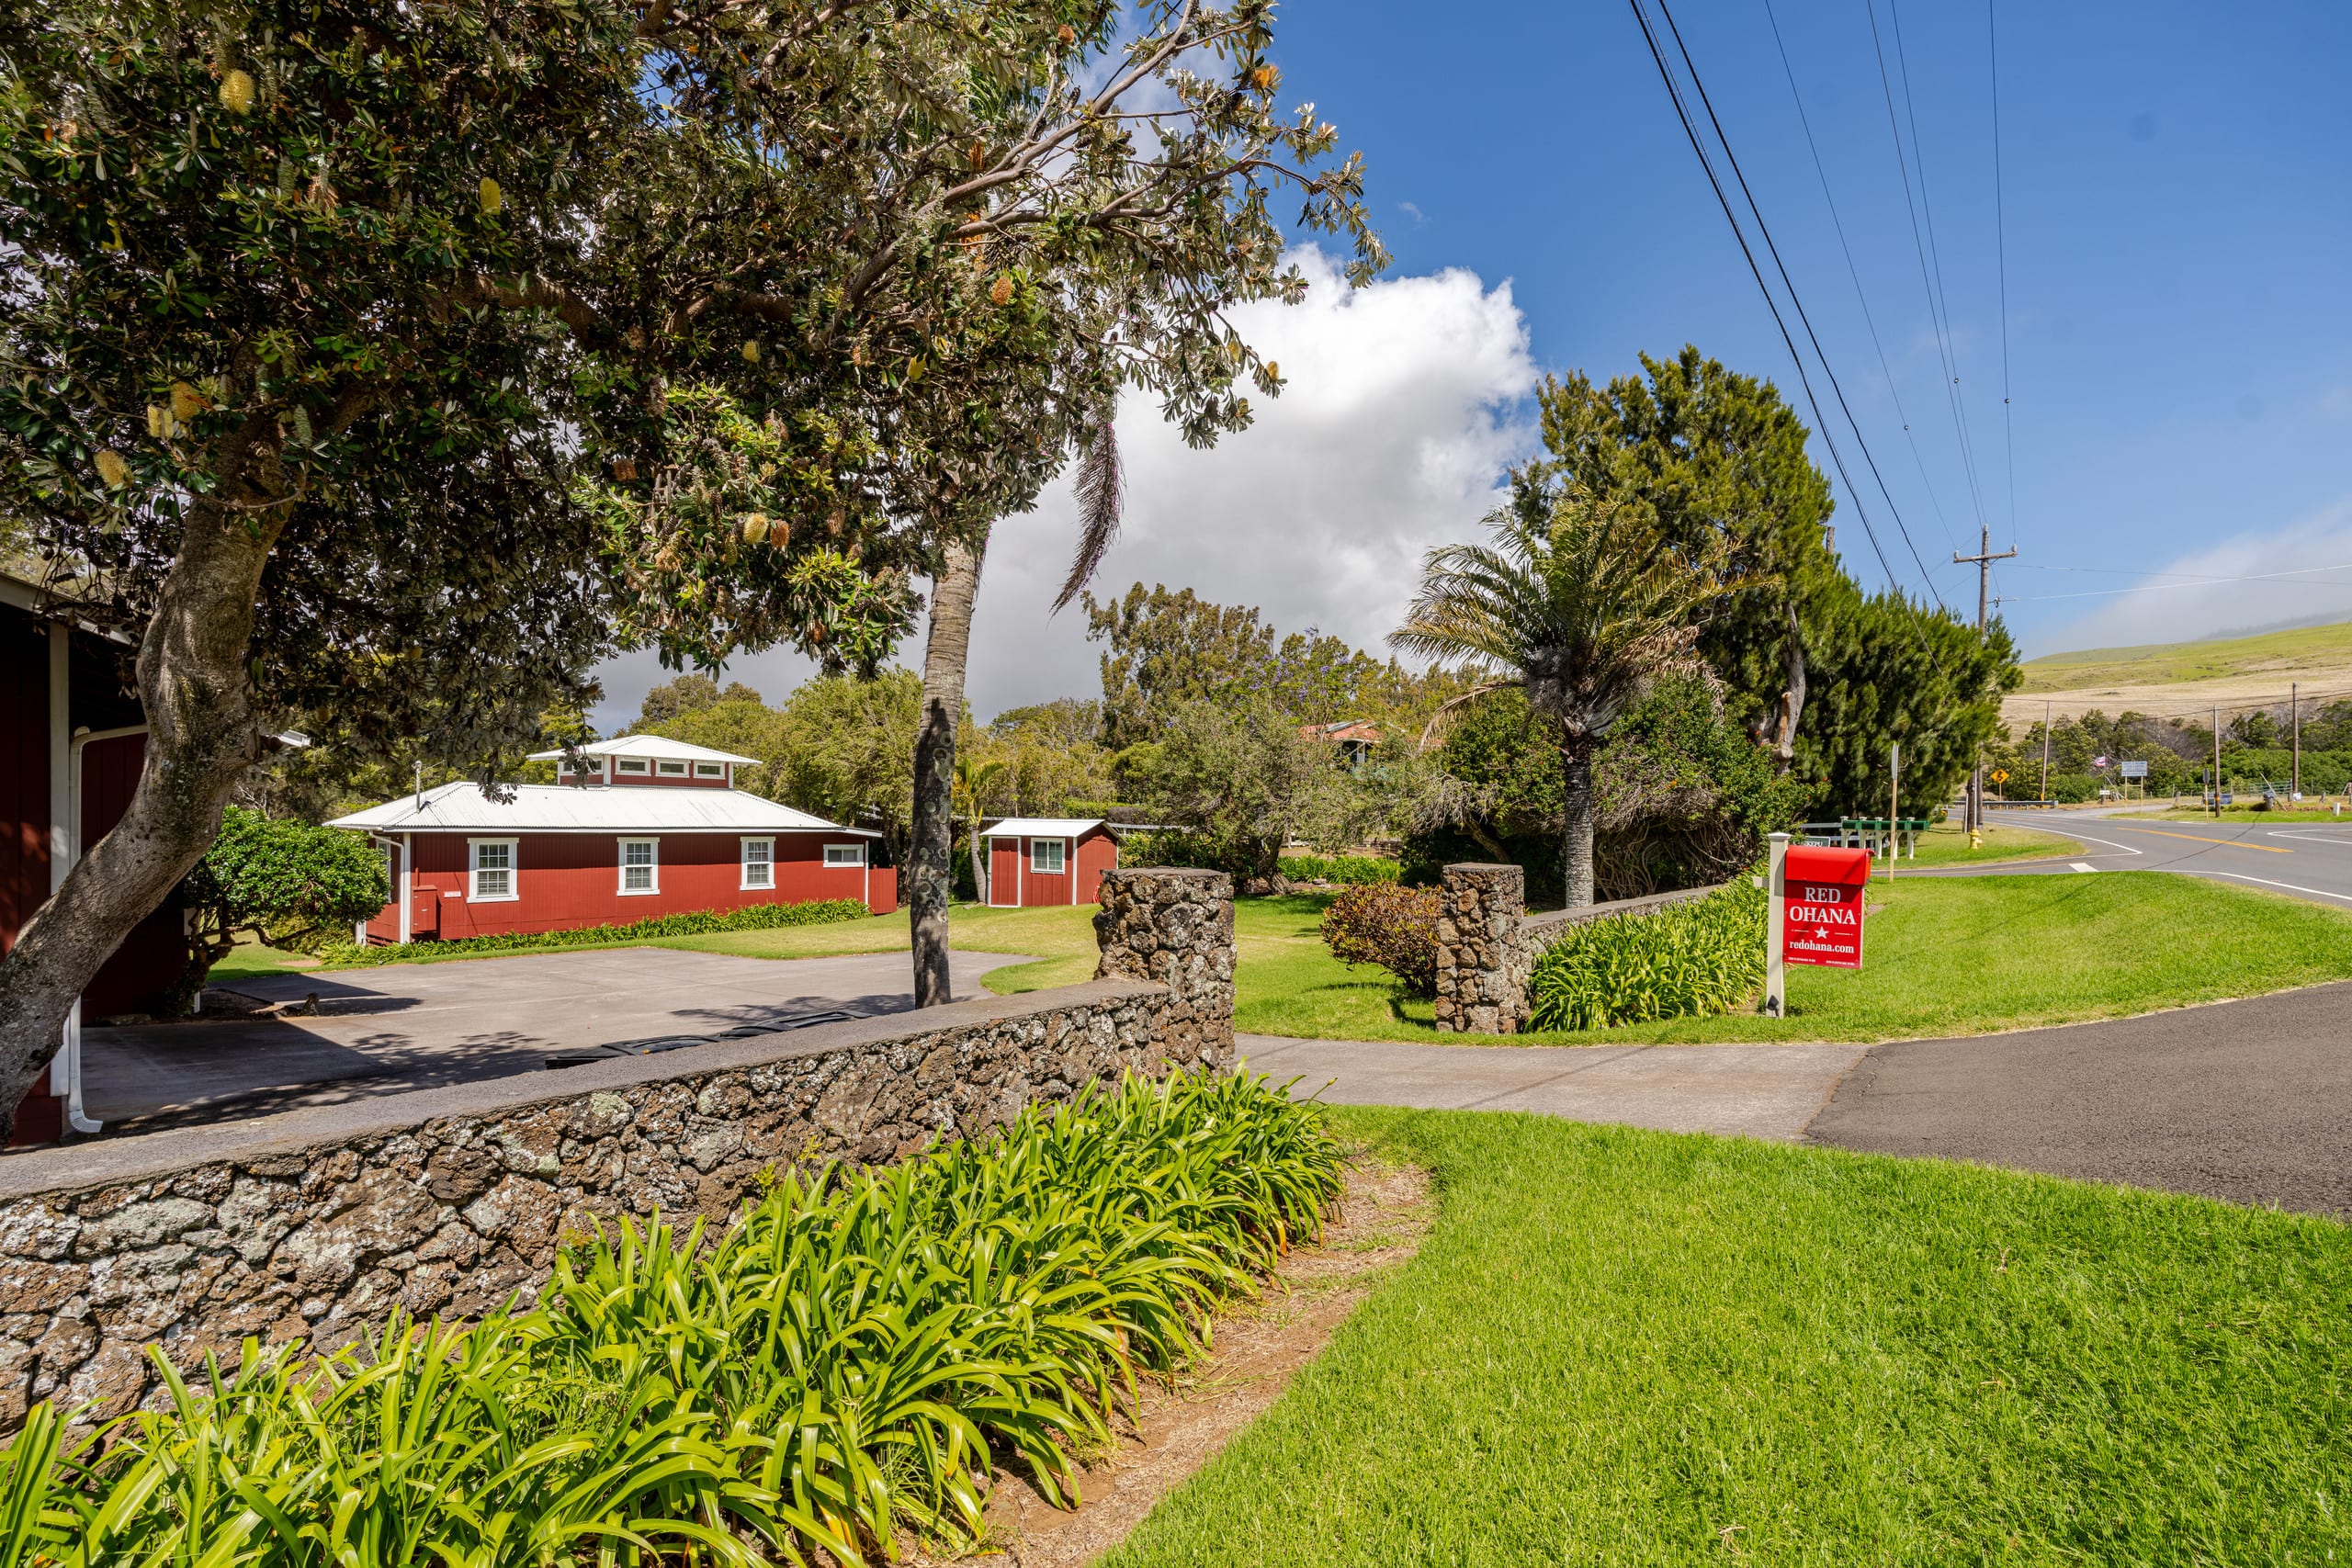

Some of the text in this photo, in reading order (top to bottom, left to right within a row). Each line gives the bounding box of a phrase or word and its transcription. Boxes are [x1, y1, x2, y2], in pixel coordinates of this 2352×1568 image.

[1804, 886, 1841, 903] RED
[1789, 906, 1857, 925] OHANA
[1789, 940, 1854, 953] redohana.com
